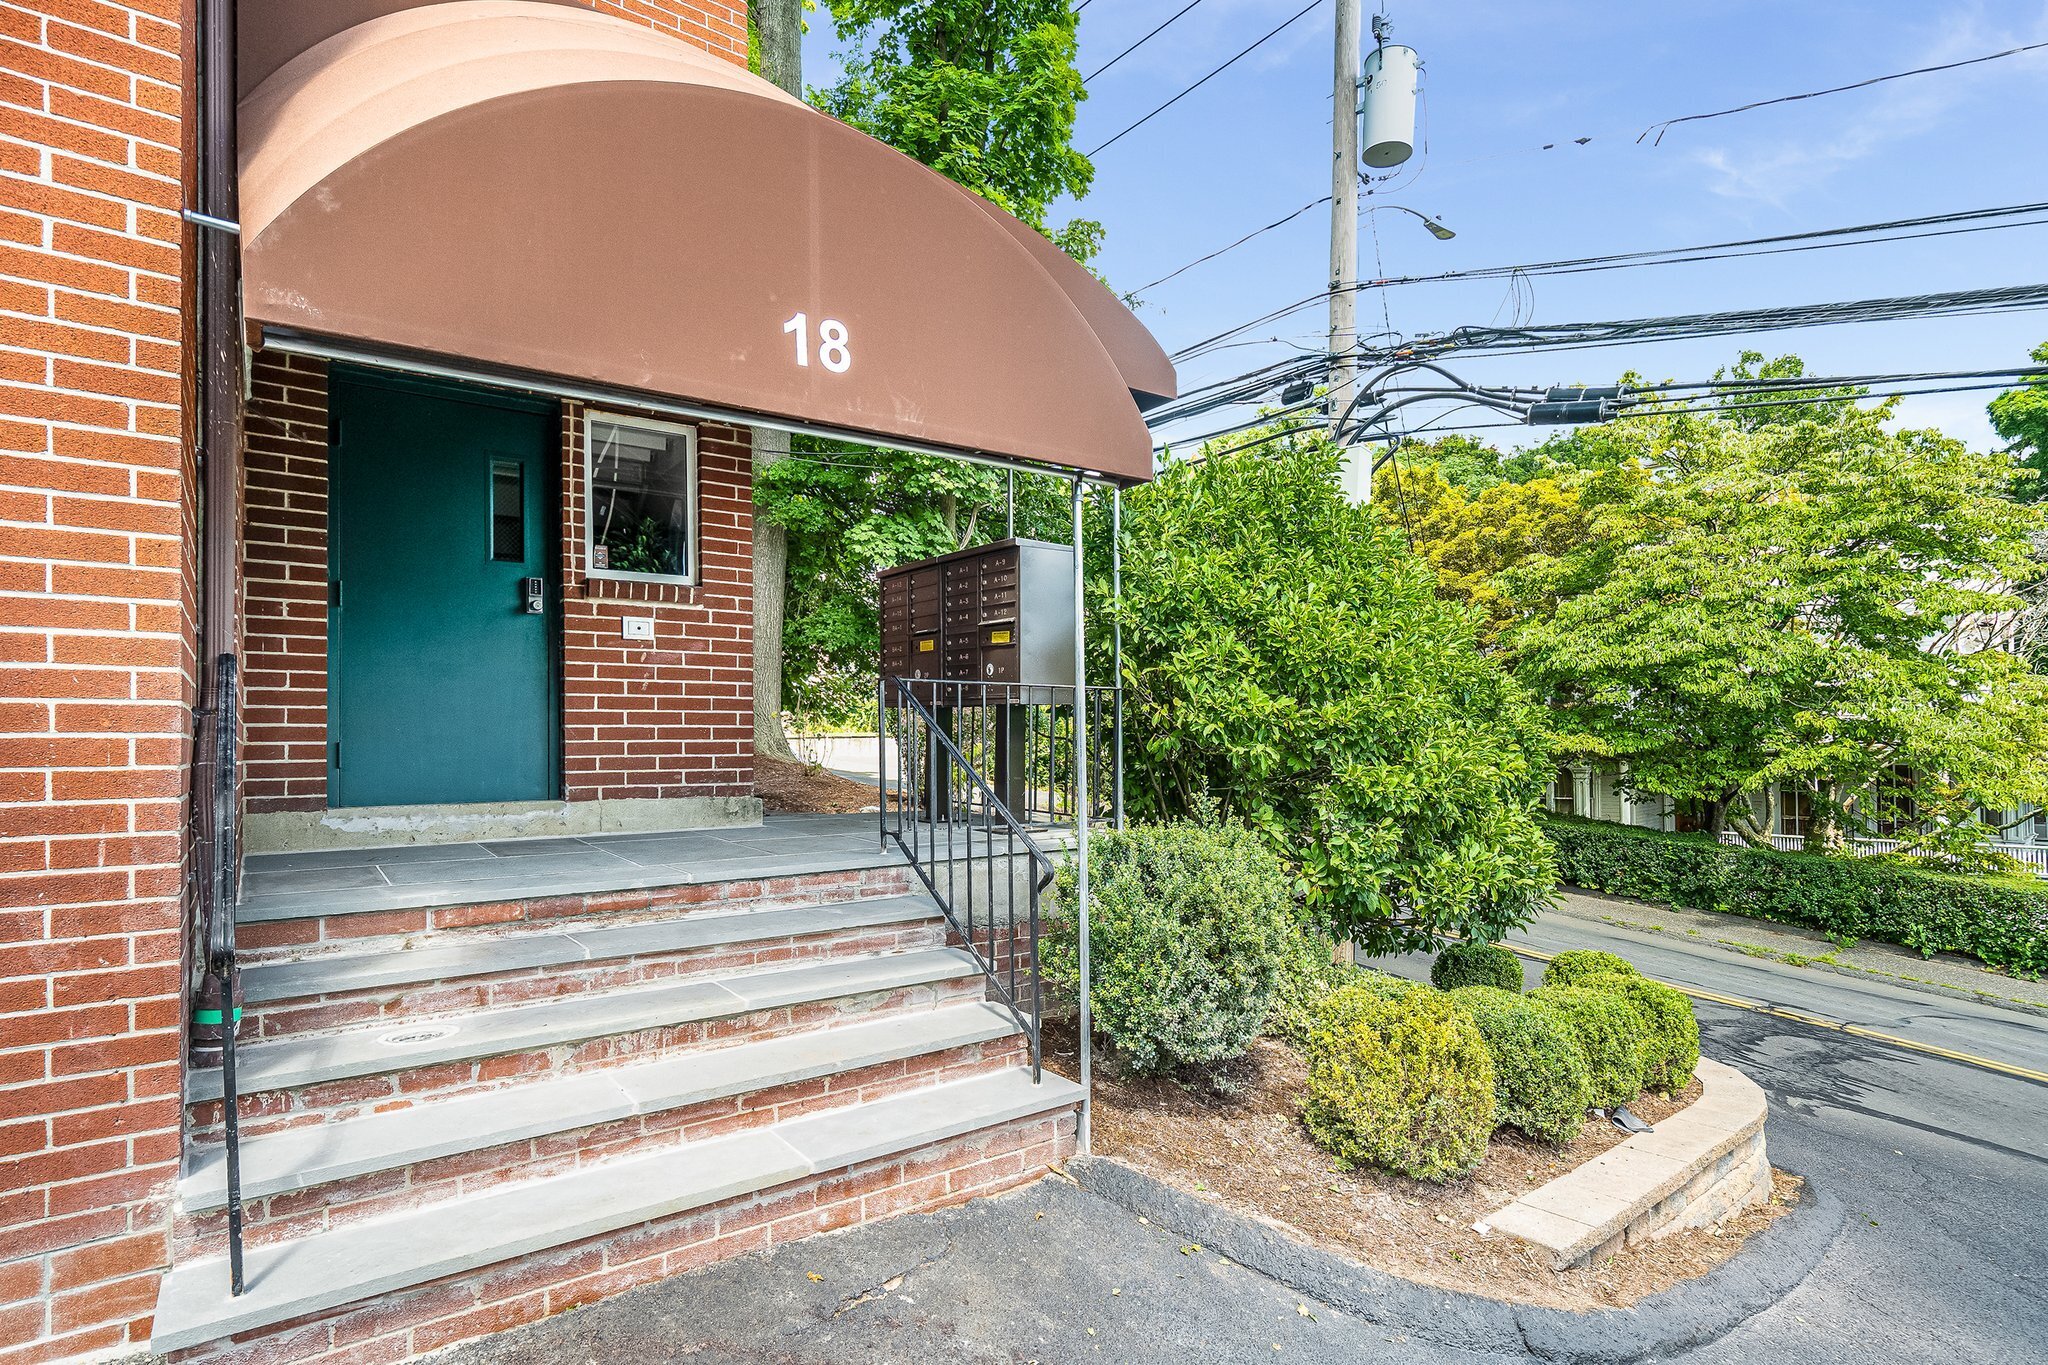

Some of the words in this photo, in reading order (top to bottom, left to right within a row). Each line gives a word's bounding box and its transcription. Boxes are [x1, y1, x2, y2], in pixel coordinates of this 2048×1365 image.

[783, 311, 851, 373] 18
[995, 558, 1006, 566] A-9
[993, 574, 1008, 583] A-10
[994, 591, 1007, 600] A-11
[993, 608, 1007, 616] A-12
